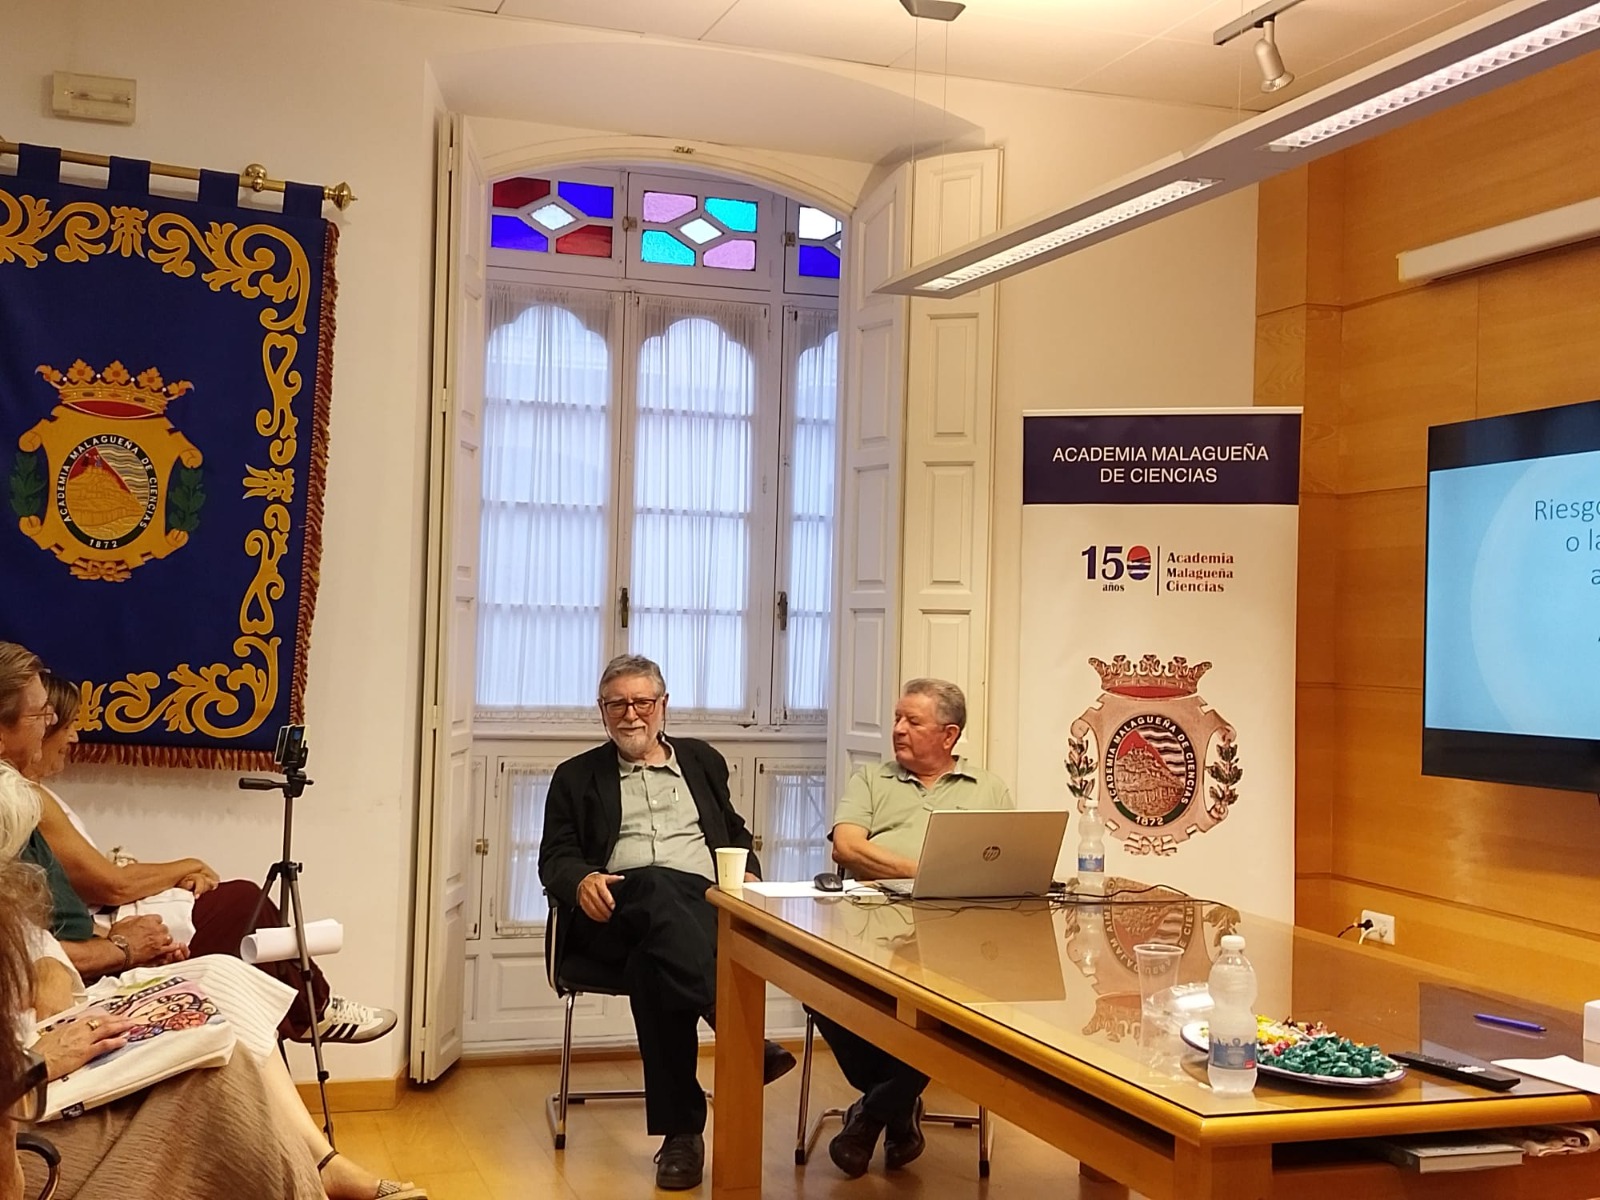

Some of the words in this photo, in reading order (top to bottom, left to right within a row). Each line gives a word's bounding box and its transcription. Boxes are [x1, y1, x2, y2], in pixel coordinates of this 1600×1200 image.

[70, 435, 139, 460] MALAGUEÑA
[1052, 447, 1147, 462] ACADEMIA
[1152, 443, 1269, 462] MALAGUEÑA
[141, 457, 153, 471] DE
[1100, 468, 1125, 483] DE
[1130, 467, 1218, 483] CIENCIAS
[57, 465, 72, 522] ACADEMIA
[140, 477, 158, 528] CIENCIAS
[89, 539, 118, 548] 1872
[1566, 536, 1580, 552] o
[1081, 545, 1151, 581] 150
[1166, 551, 1234, 564] Academia
[1166, 567, 1233, 580] Malagueña
[1102, 582, 1125, 592] años
[1166, 580, 1224, 593] Ciencias
[1113, 716, 1177, 743] MALAGUEÑA
[1177, 734, 1190, 748] DE
[1106, 748, 1120, 803] ACADEMIA
[1181, 752, 1196, 805] CIENCIAS
[1135, 816, 1164, 826] 1872
